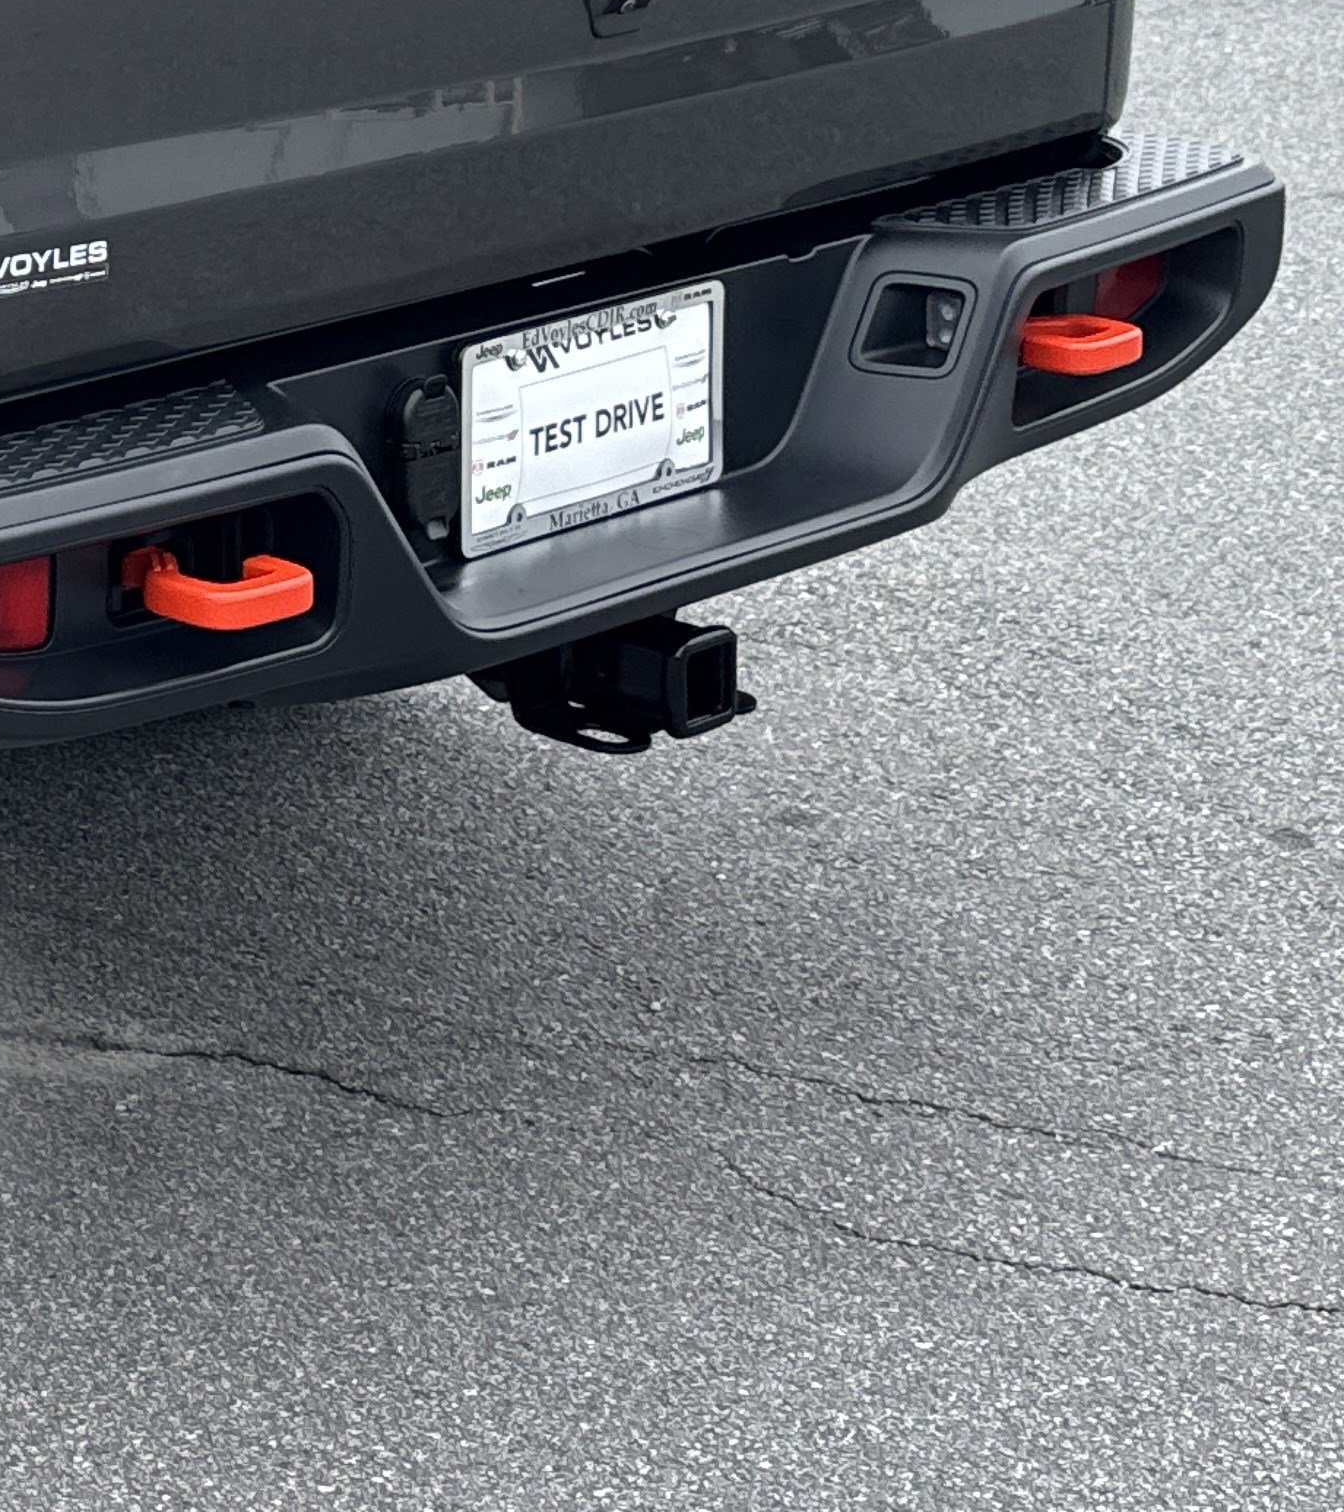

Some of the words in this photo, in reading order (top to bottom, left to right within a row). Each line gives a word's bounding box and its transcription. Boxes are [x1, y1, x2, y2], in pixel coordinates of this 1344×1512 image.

[475, 342, 504, 360] Jeep
[529, 414, 587, 456] TEST
[595, 391, 665, 439] DRIVE
[676, 426, 705, 446] Jeep
[475, 484, 512, 505] Jeep
[616, 489, 641, 510] GA
